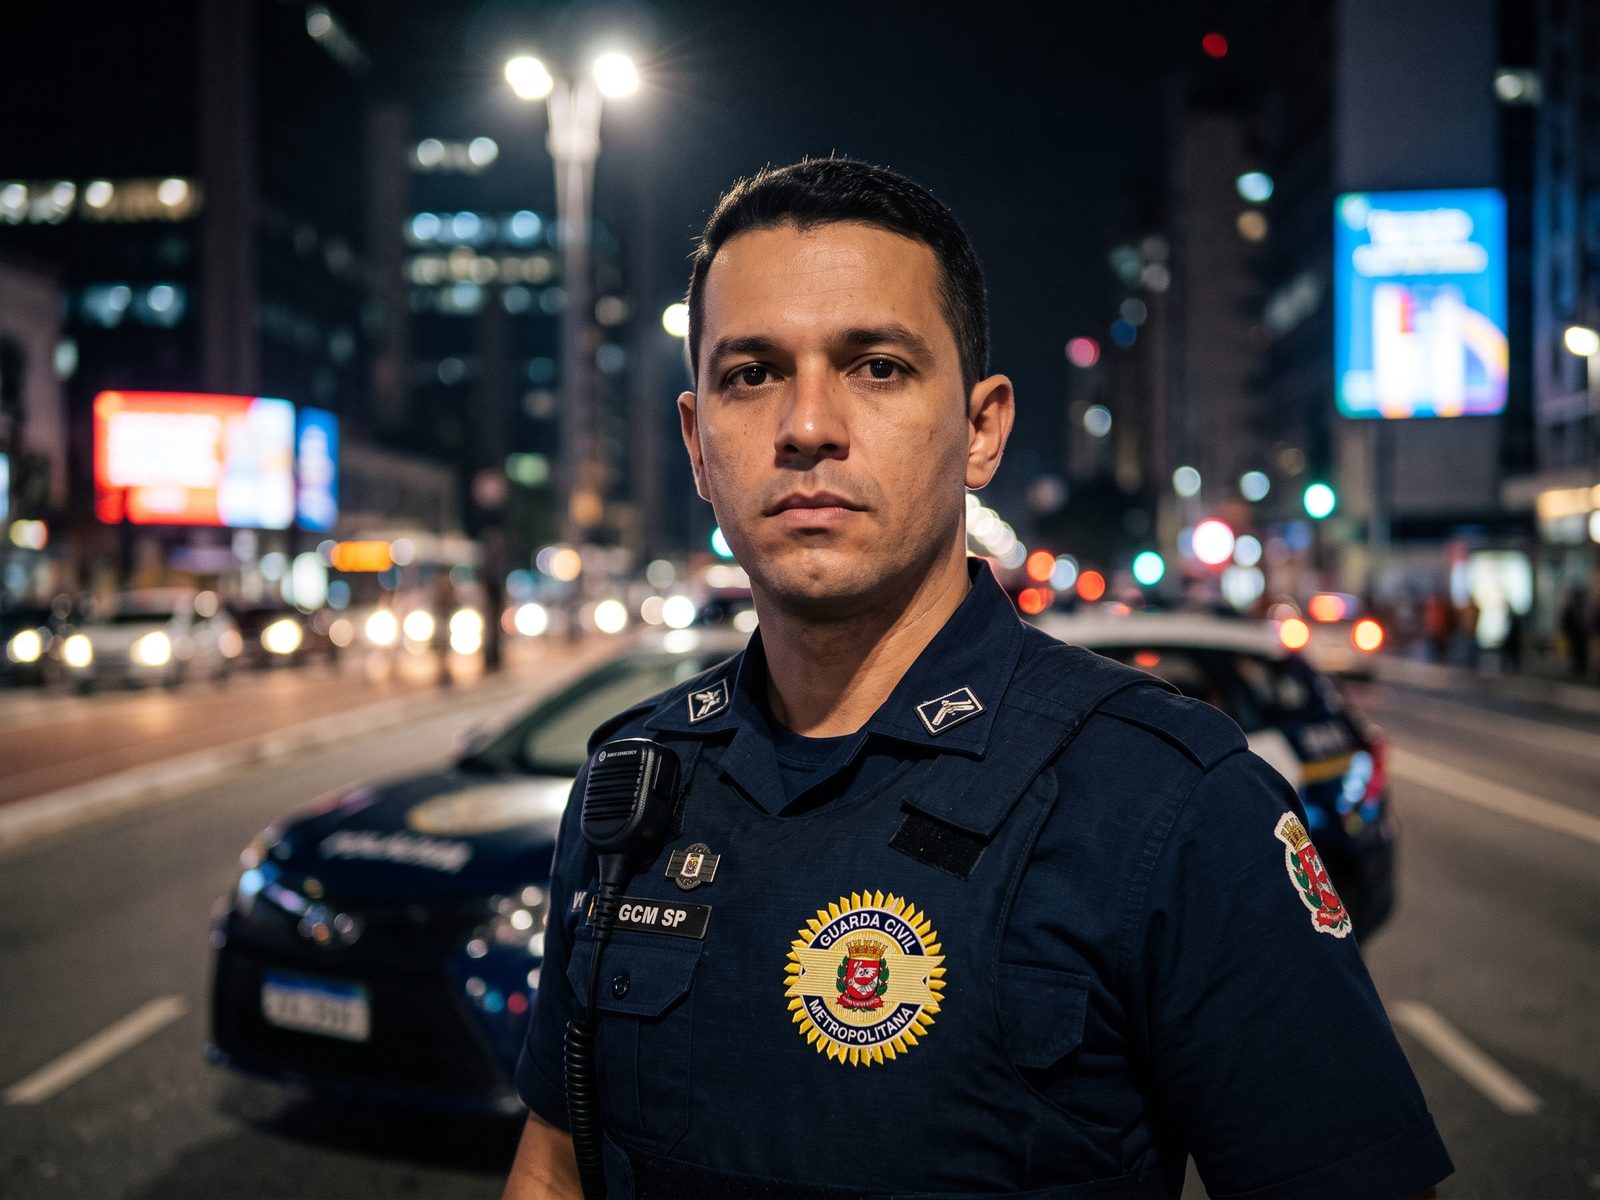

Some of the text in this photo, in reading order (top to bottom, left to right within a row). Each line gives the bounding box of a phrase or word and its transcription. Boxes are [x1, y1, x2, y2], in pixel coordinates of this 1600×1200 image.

[618, 904, 687, 928] GCM SP
[820, 913, 917, 954] GUARDA CIVIL
[809, 998, 914, 1043] METROPOLITANA
